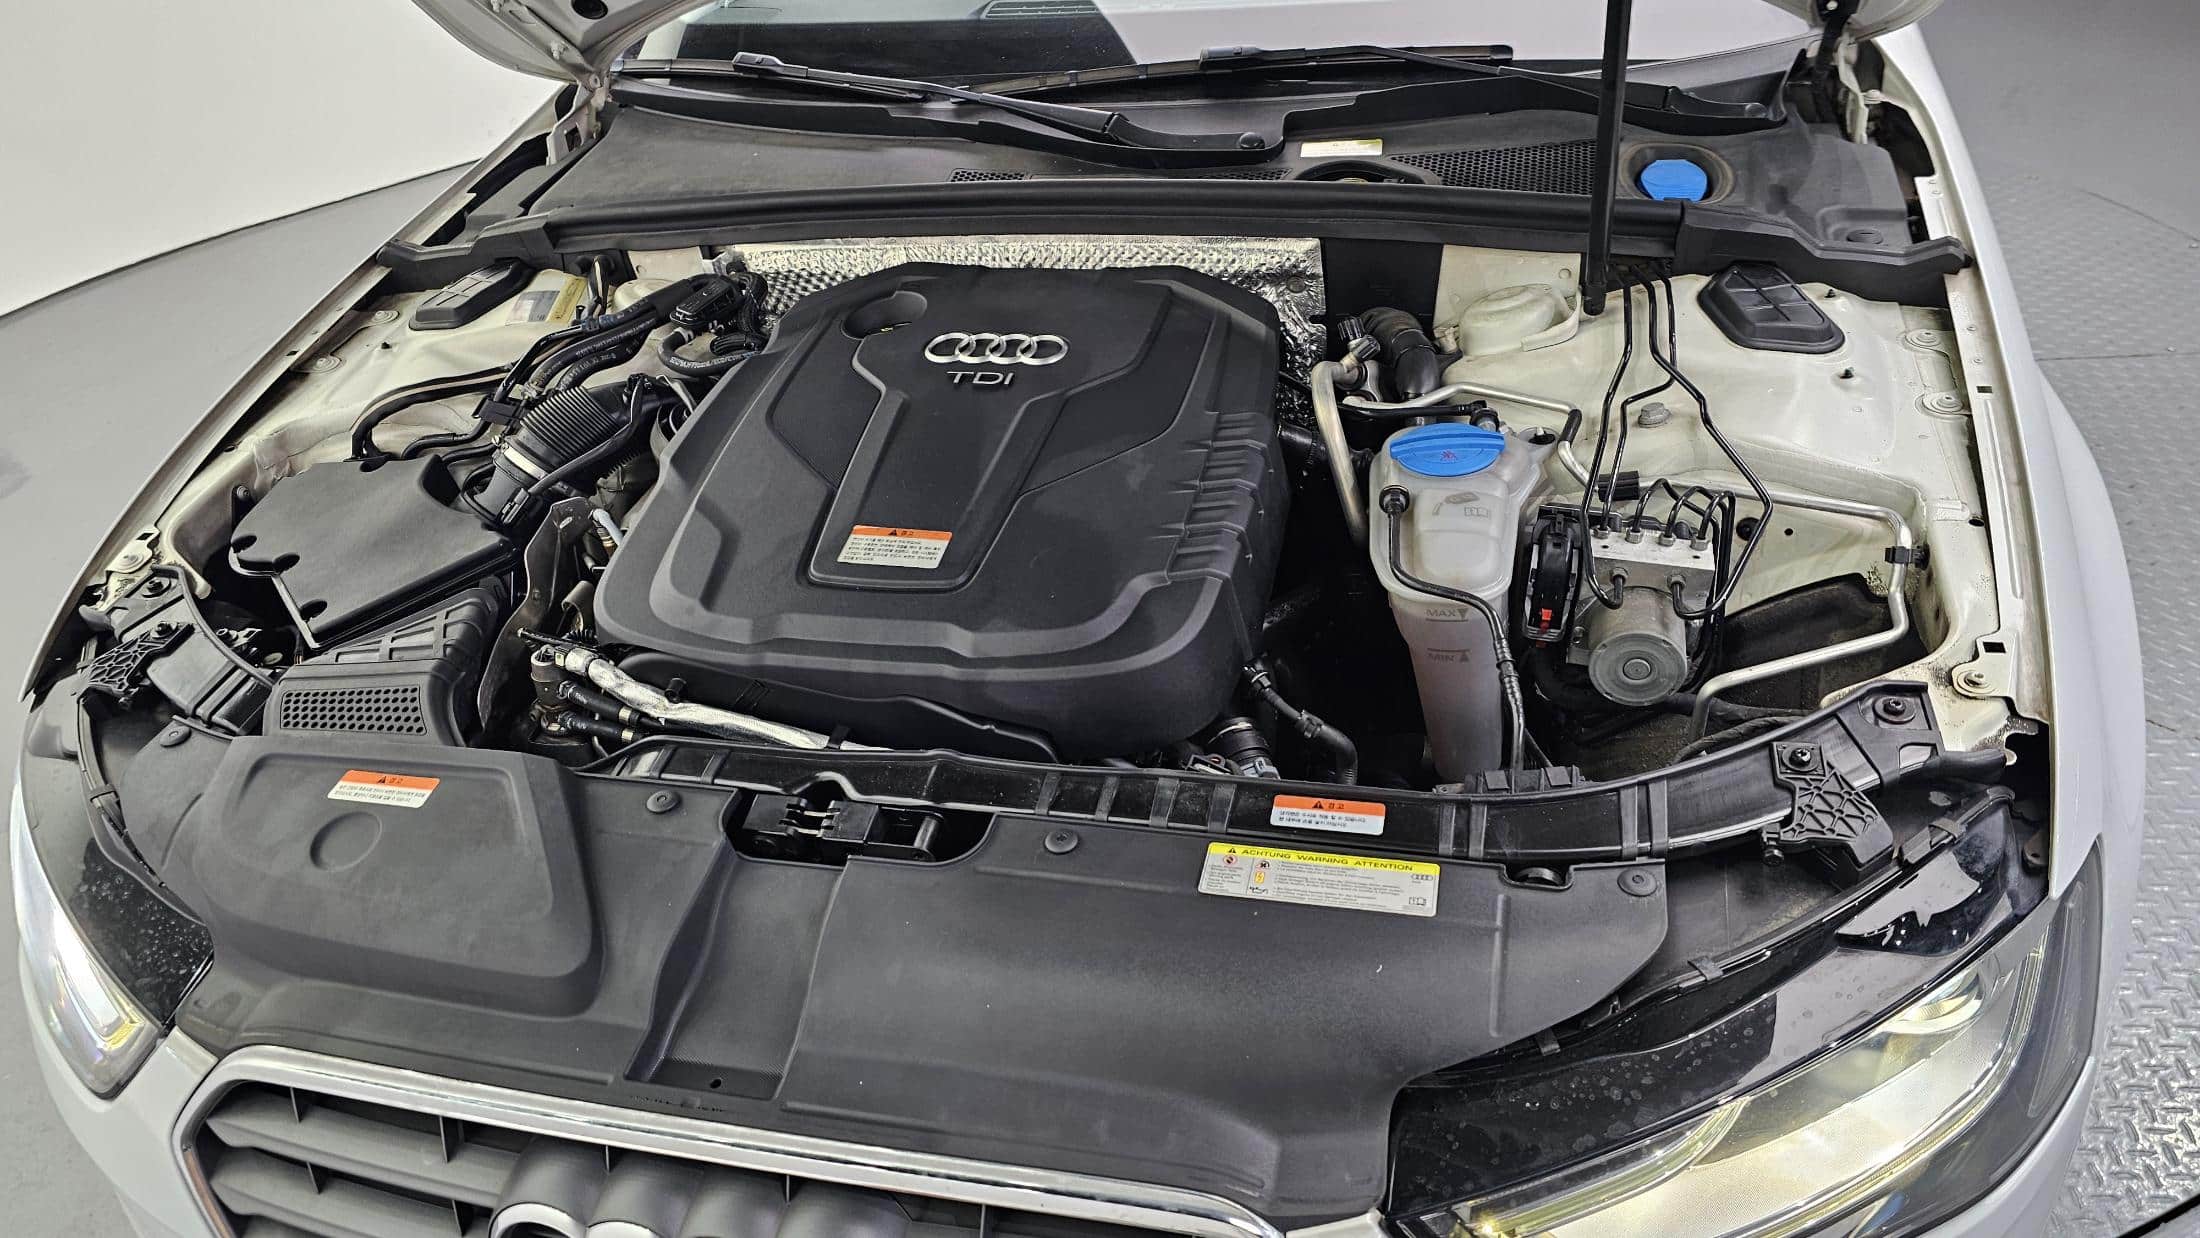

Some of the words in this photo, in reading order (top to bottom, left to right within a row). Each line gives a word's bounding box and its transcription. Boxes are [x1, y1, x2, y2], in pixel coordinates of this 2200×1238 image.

[947, 371, 1014, 385] TDI
[1426, 609, 1456, 617] MAX
[1241, 849, 1291, 859] ACHTUNG
[1297, 855, 1348, 865] WARNING
[1353, 860, 1413, 871] ATTENTION
